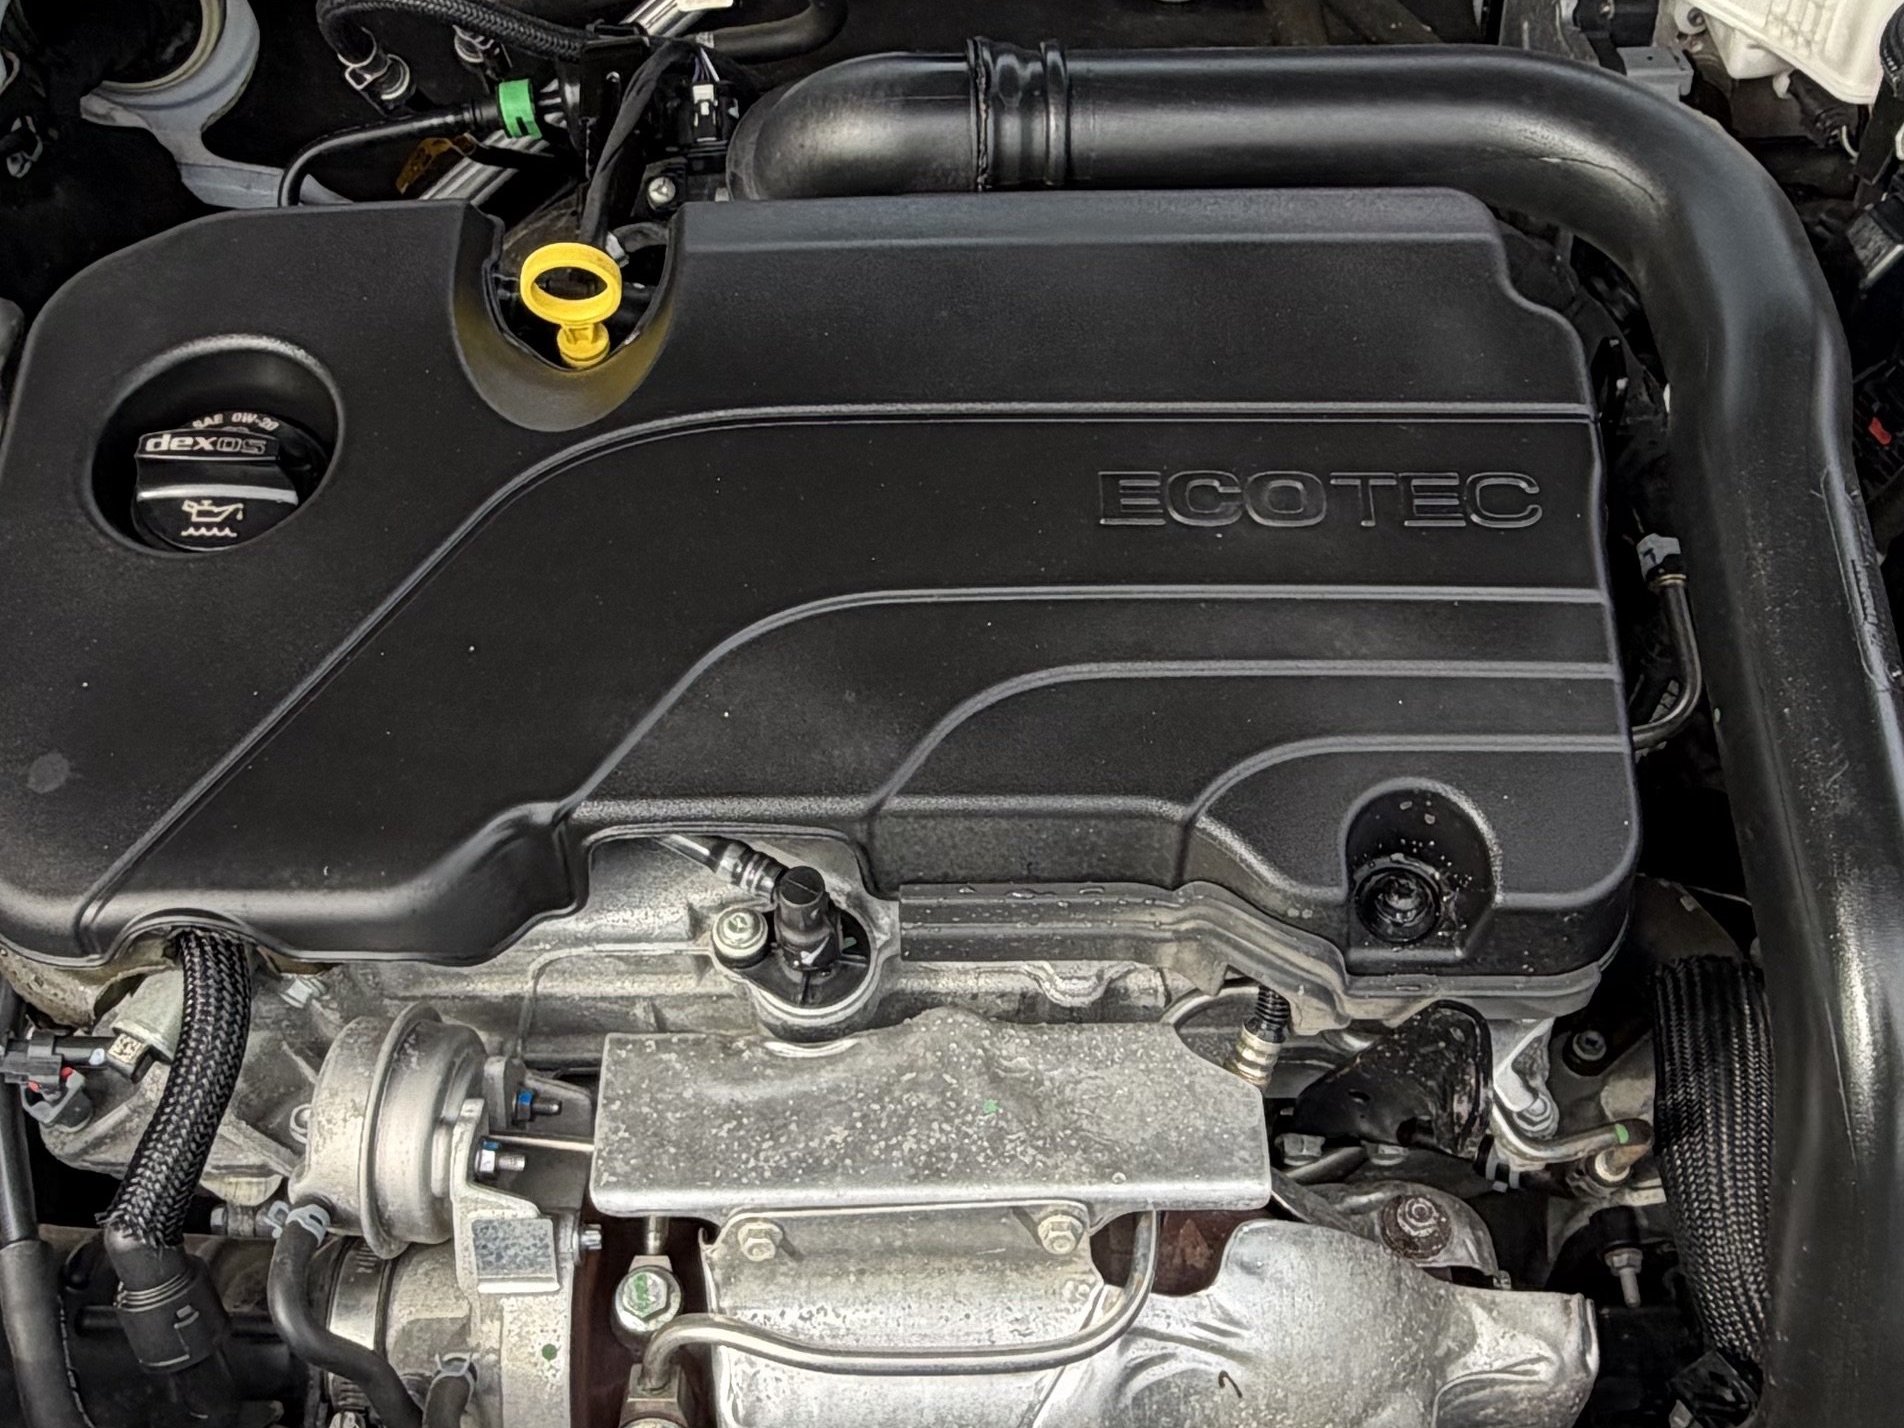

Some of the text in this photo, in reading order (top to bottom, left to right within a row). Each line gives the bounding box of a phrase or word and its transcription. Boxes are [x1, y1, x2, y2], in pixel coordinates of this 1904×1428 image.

[192, 412, 279, 432] SAE 0W-20
[145, 433, 267, 455] dexos
[1098, 470, 1543, 528] ECOTEC
